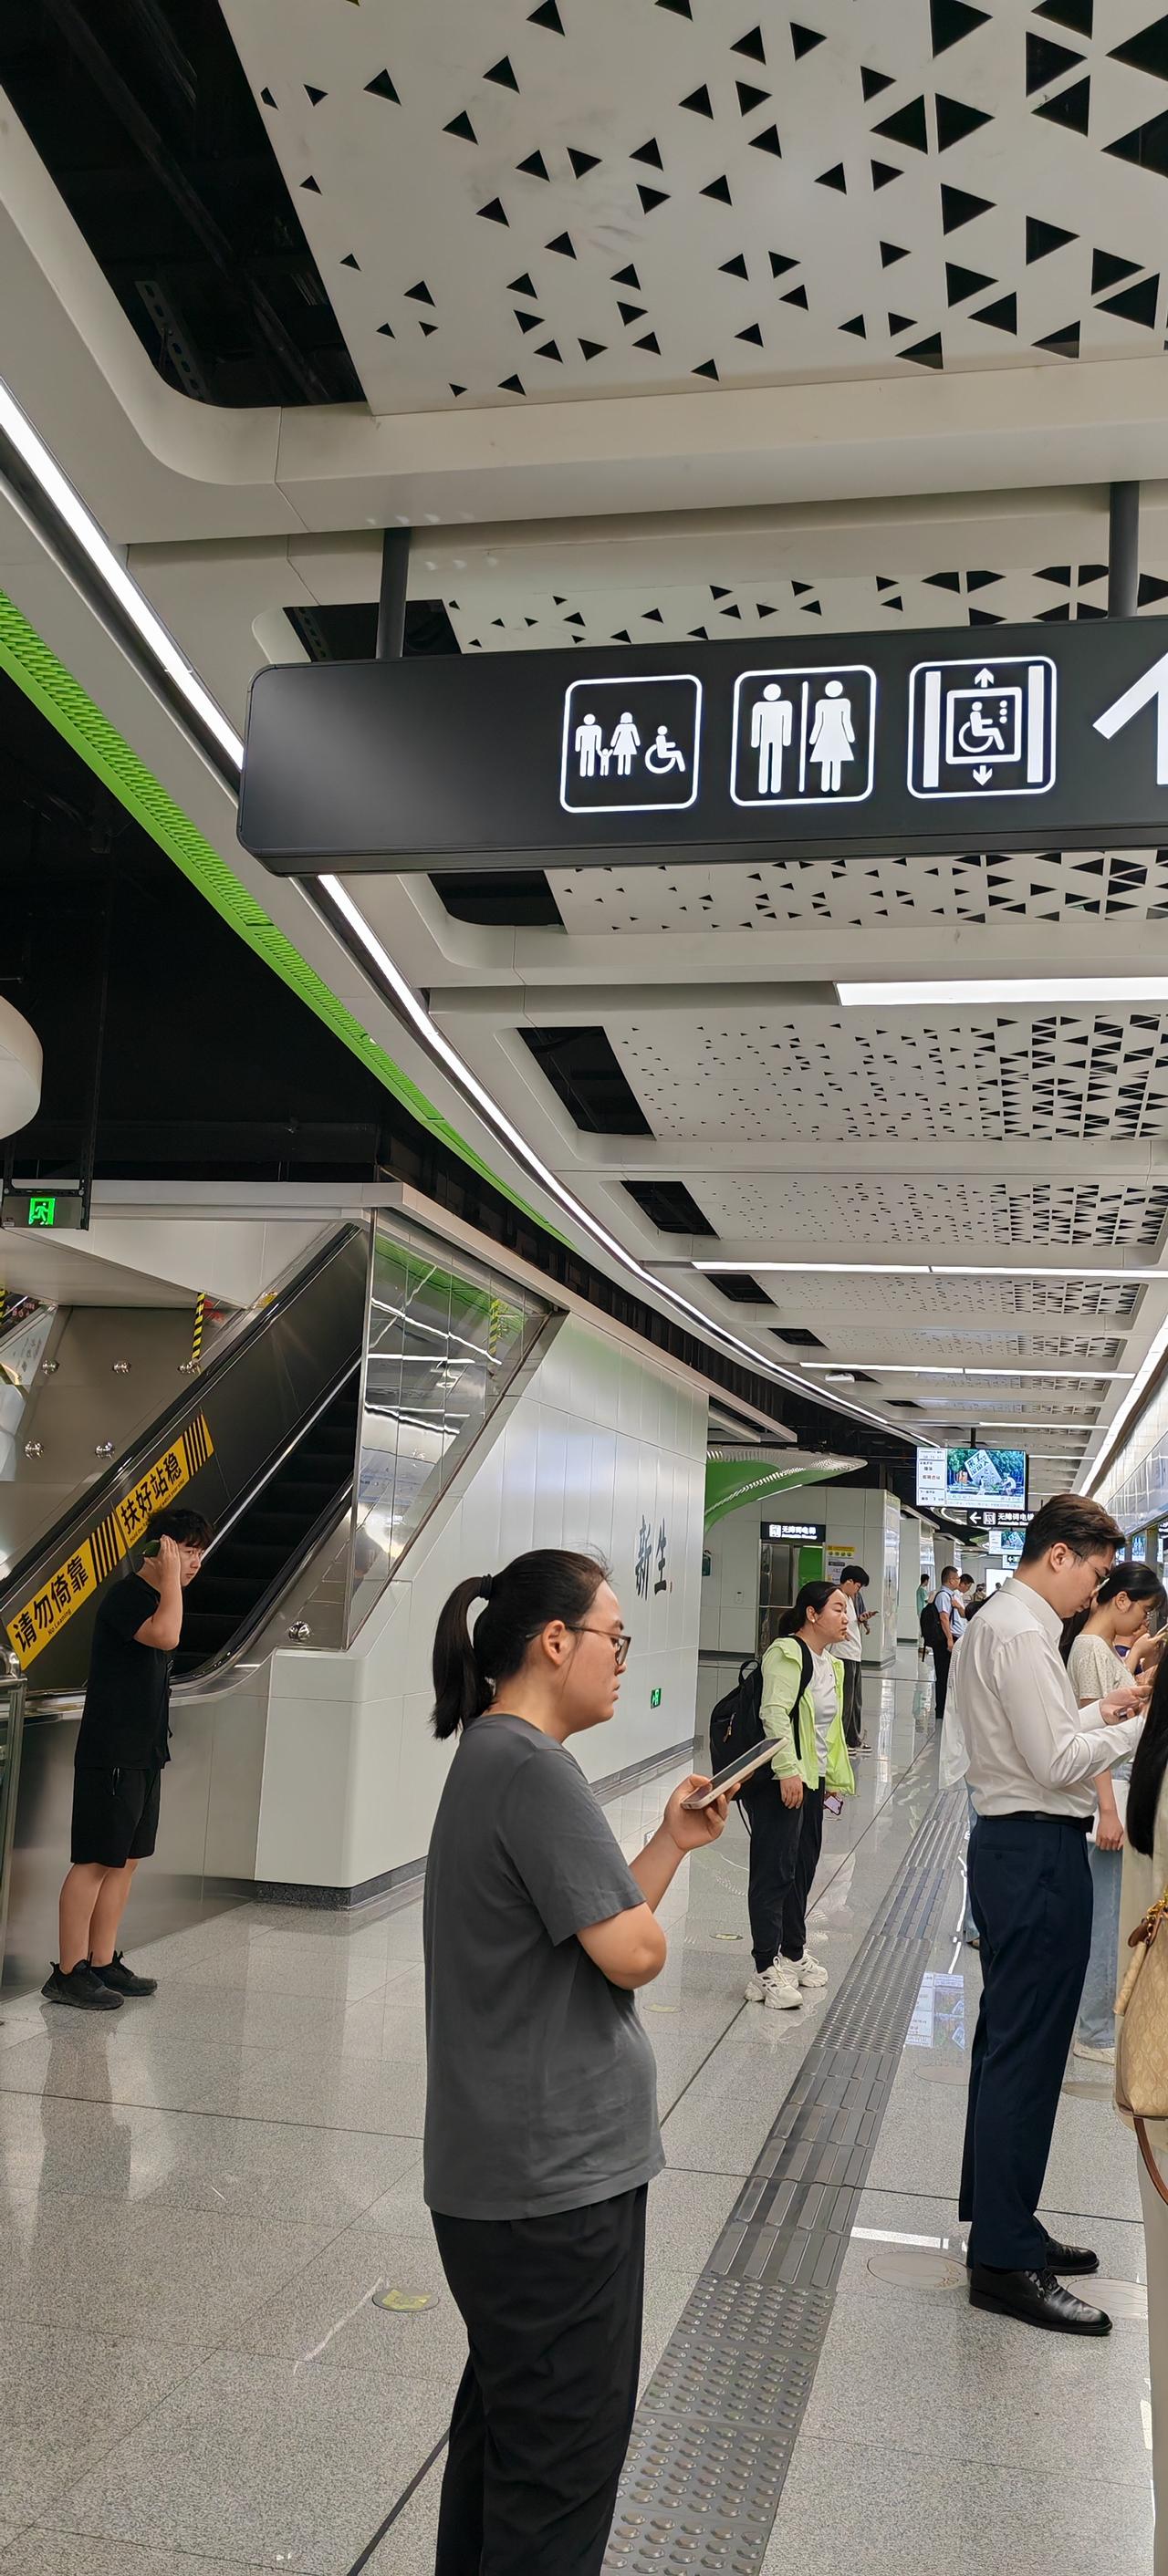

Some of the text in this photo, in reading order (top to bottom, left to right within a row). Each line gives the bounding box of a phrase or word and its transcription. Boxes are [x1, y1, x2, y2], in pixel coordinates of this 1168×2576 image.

[120, 1452, 182, 1534] 扶好站稳
[13, 1555, 89, 1652] 请勿倚靠
